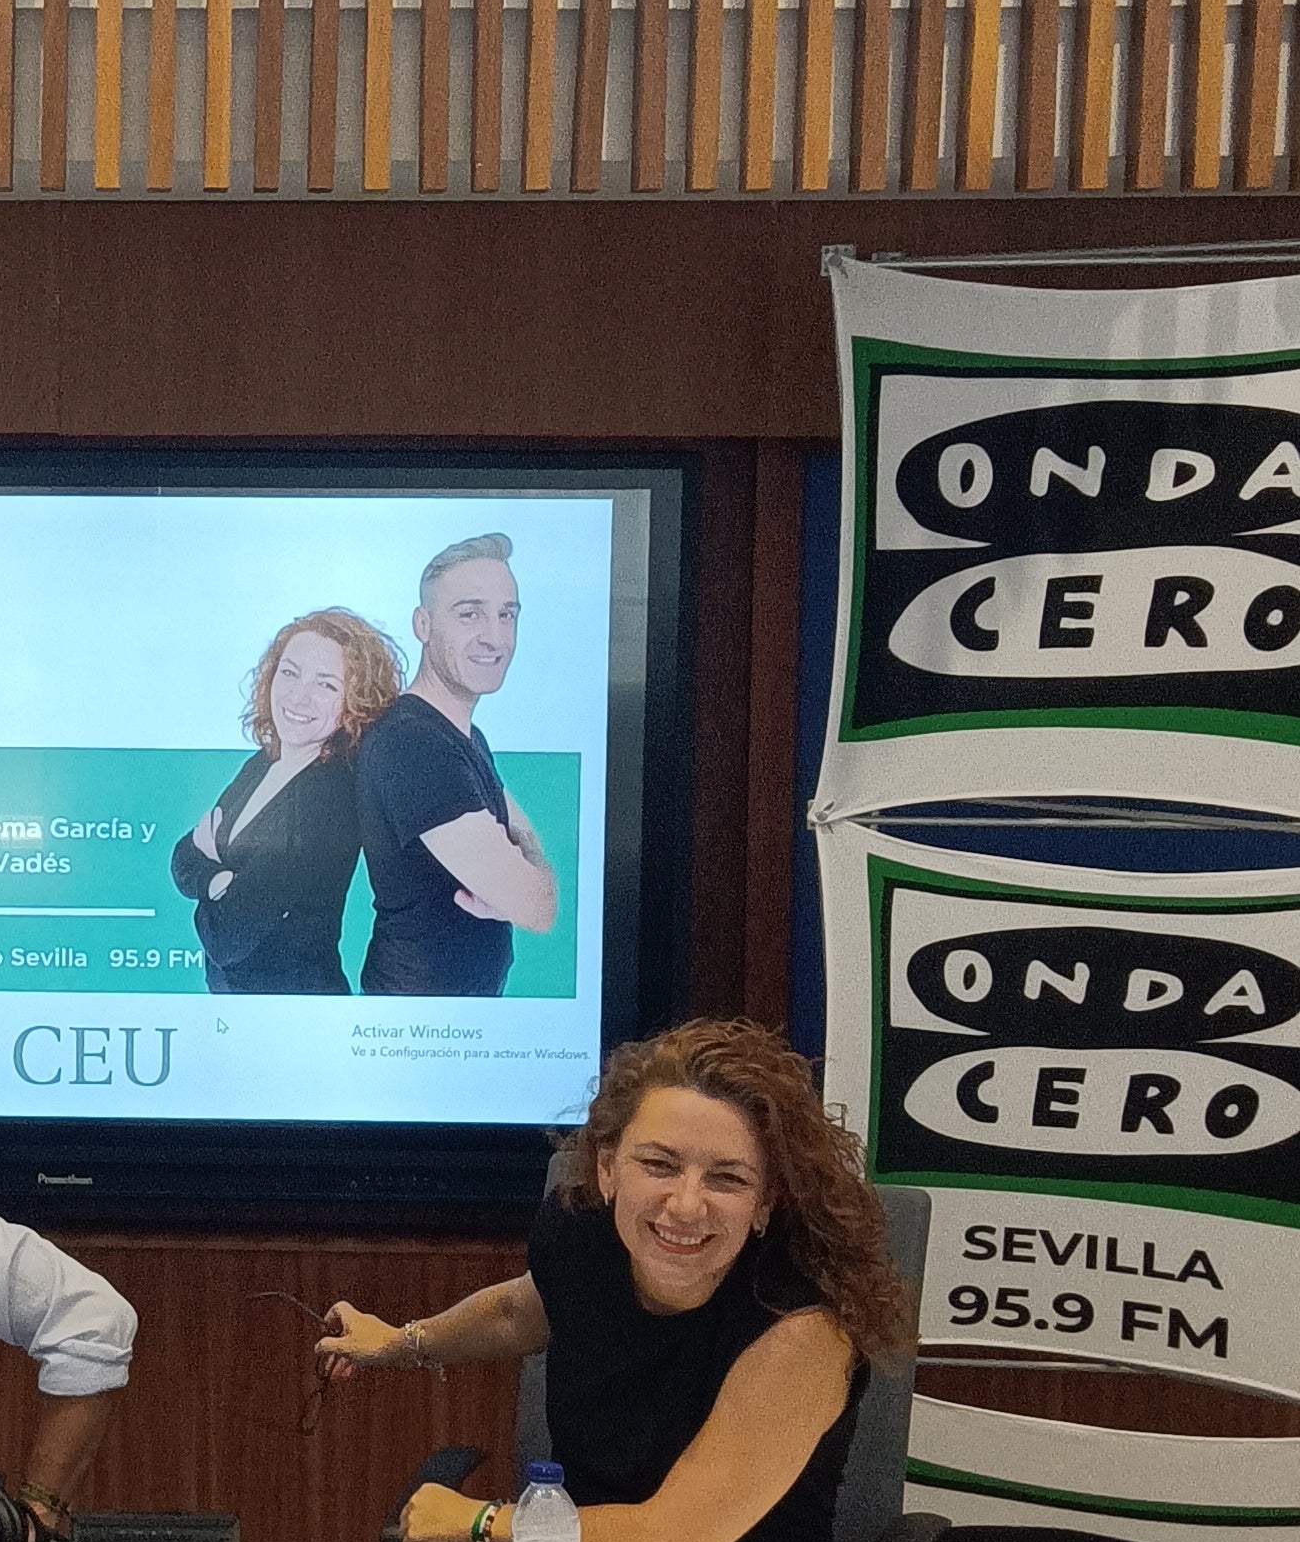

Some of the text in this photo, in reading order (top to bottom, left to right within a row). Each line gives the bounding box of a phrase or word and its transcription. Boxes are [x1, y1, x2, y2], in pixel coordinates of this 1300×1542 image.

[937, 441, 1300, 508] ONDA
[949, 574, 1300, 651] CERO
[50, 816, 133, 839] García
[141, 822, 156, 843] y
[11, 947, 88, 968] Sevilla
[109, 948, 160, 968] 95.9
[169, 949, 203, 968] FM
[943, 949, 1266, 1015] ONDA
[12, 1025, 178, 1087] CEU
[351, 1023, 483, 1040] Activar Windows
[351, 1045, 366, 1057] Ve
[379, 1045, 461, 1060] Configuración
[464, 1049, 490, 1061] para
[493, 1047, 531, 1059] activar
[956, 1060, 1260, 1139] CERO
[962, 1224, 1224, 1291] SEVILLA
[947, 1284, 1230, 1359] 95.9 FM
